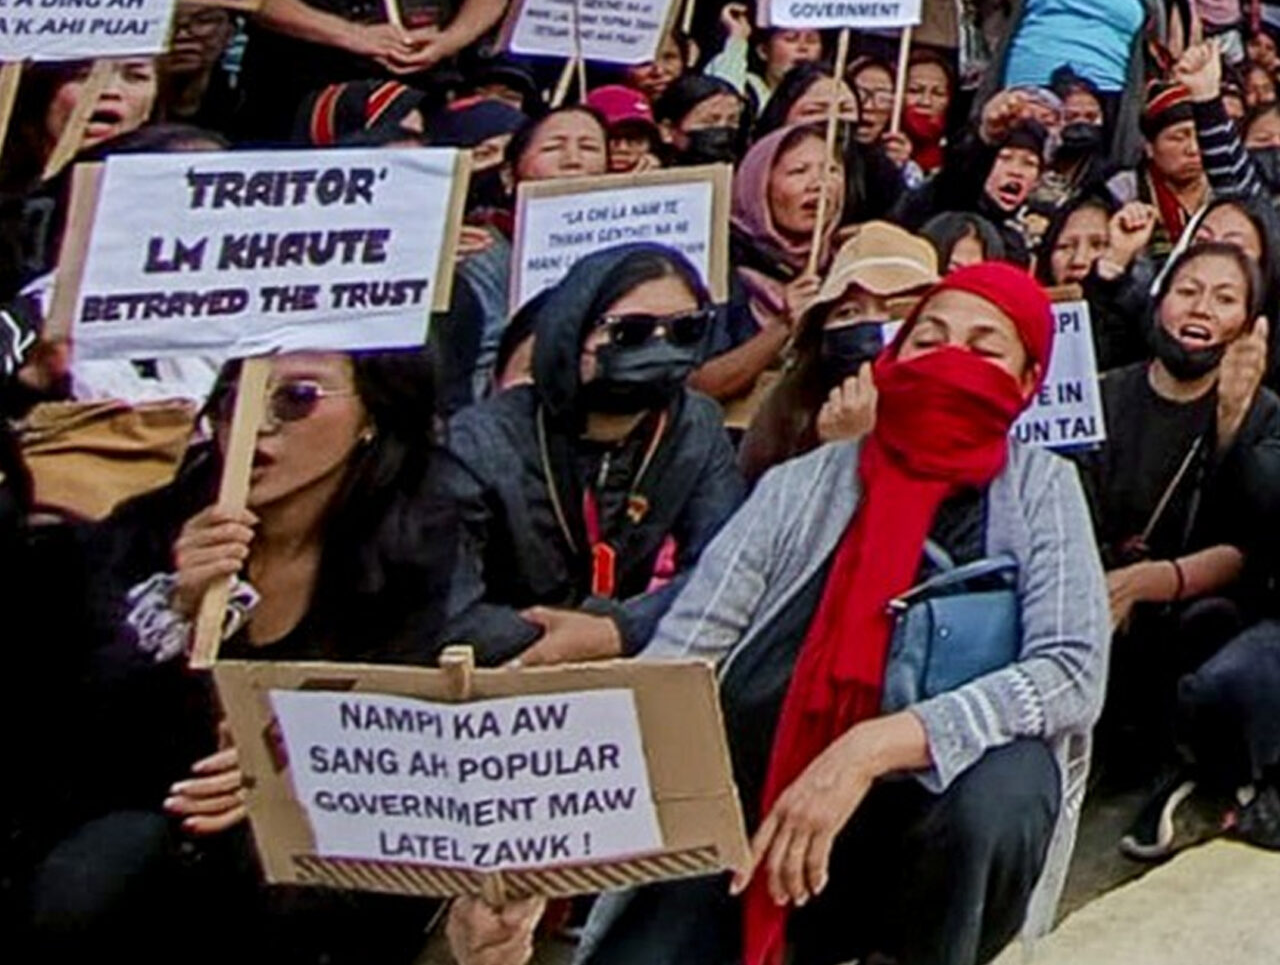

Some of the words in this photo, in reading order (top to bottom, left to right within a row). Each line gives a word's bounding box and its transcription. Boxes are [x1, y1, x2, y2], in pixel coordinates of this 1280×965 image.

[38, 16, 86, 35] AHI
[789, 2, 900, 19] GOVERNMENT
[143, 236, 208, 274] LM
[217, 228, 391, 271] KHAUTE
[80, 288, 249, 324] BETRAYED
[260, 285, 321, 313] THE
[331, 279, 429, 310] TRUST
[1052, 311, 1080, 334] PI
[1058, 382, 1083, 404] IN
[340, 703, 443, 738] NAMPI
[453, 711, 501, 740] KA
[511, 703, 570, 736] AW
[309, 745, 398, 776] SANG
[408, 749, 448, 777] AH
[458, 743, 621, 784] POPULAR
[315, 790, 538, 827] GOVERNMENT
[548, 788, 637, 819] MAW
[379, 830, 467, 861] LATEL
[472, 834, 572, 867] ZAWK
[582, 832, 593, 856] !
